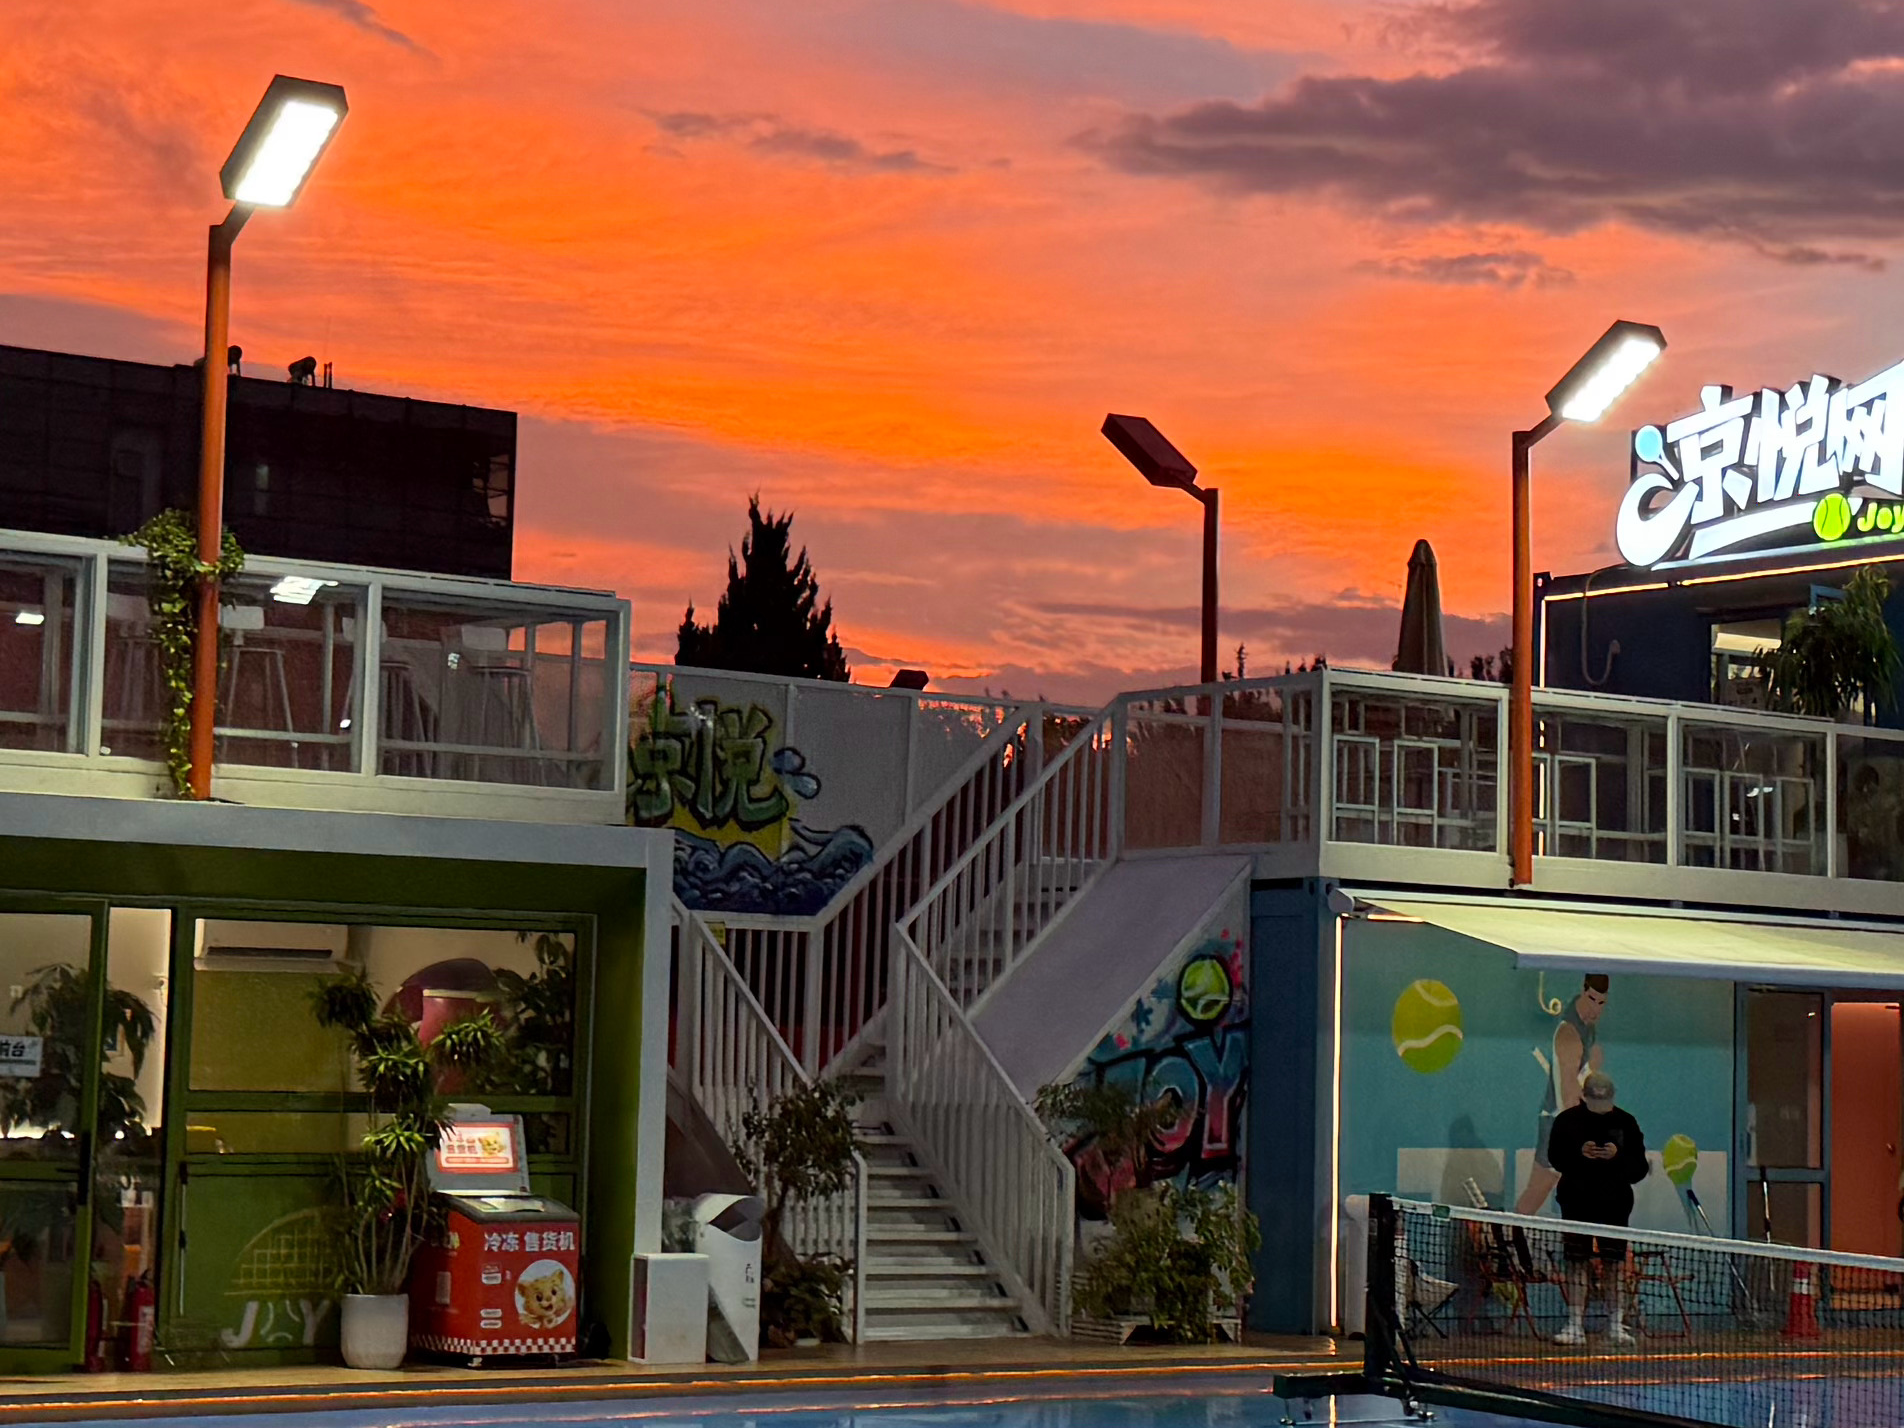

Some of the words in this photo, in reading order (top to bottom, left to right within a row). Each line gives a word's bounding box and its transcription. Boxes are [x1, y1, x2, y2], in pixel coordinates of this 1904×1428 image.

[483, 1231, 520, 1252] 冷冻
[523, 1231, 576, 1252] 售货机
